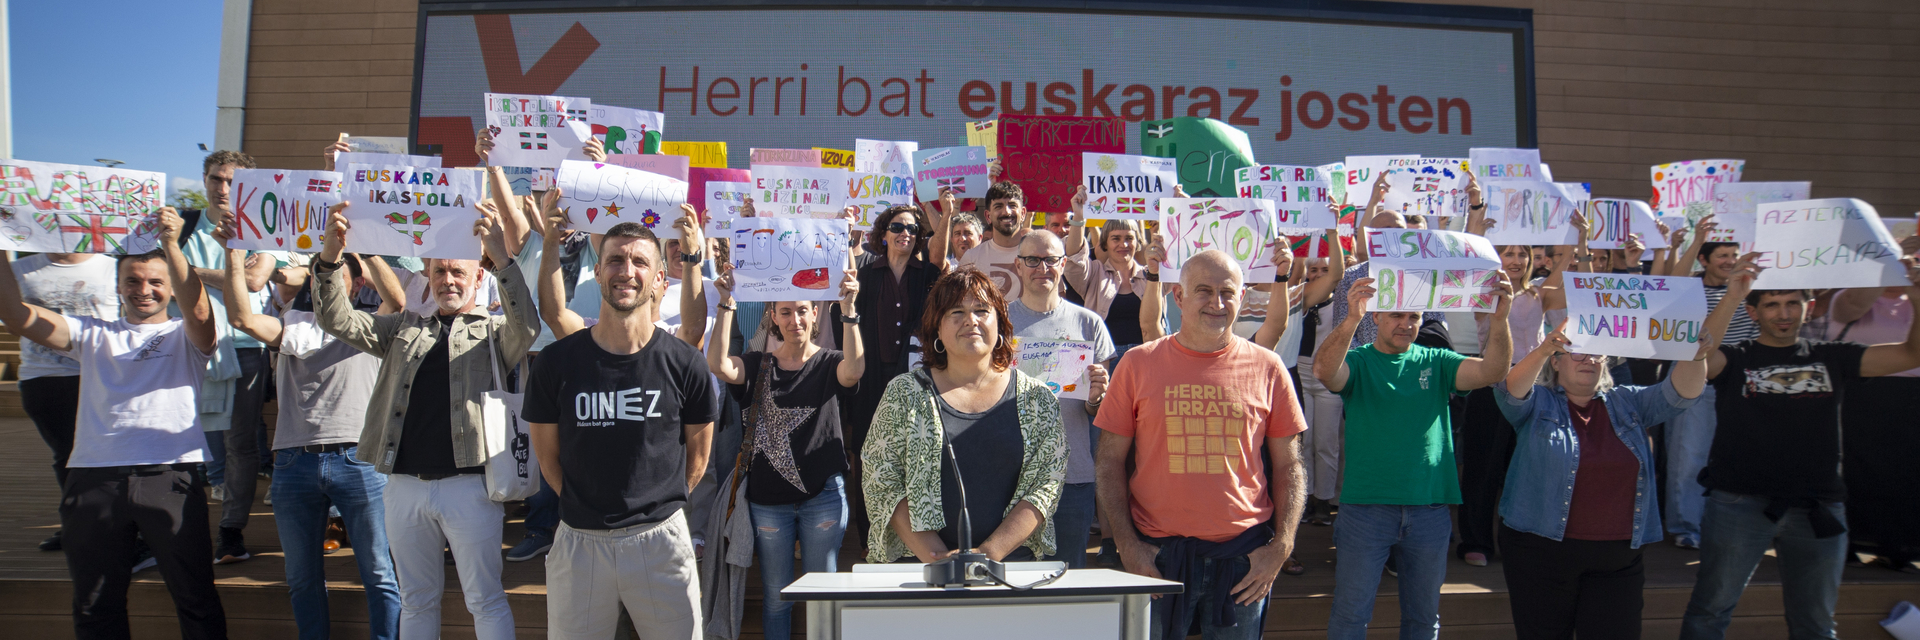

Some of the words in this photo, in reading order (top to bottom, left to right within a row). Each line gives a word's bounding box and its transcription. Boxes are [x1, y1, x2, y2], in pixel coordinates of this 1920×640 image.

[658, 63, 808, 117] Herri
[836, 66, 935, 118] bat
[958, 69, 1259, 127] euskaraz
[1275, 75, 1473, 141] josten
[501, 115, 565, 128] EUSKARAZ
[1004, 121, 1125, 147] ETORKIZUNA
[821, 151, 855, 168] UZOLA
[1388, 158, 1450, 167] ETORKIZUNA
[355, 170, 449, 186] EUSKARA
[918, 164, 987, 182] ETORKIZUNA
[1239, 166, 1328, 183] EUSKARAZ
[1479, 164, 1532, 177] HERRIA
[0, 165, 160, 217] EUSKARA
[557, 169, 687, 207] EUSKARA
[757, 178, 829, 191] EUSKARAZ
[846, 175, 914, 199] USKARAZ
[1088, 175, 1162, 194] IKASTOLA
[369, 189, 465, 208] IKASTOLA
[735, 228, 848, 270] EUSKARA
[1367, 231, 1479, 259] EUSKARA
[1377, 268, 1438, 311] BIZI
[1573, 276, 1670, 291] EUSKARAZ
[1648, 318, 1699, 343] DUGU
[1164, 383, 1223, 400] HERRI
[575, 386, 662, 421] OINEZ
[1164, 400, 1244, 418] URRATS
